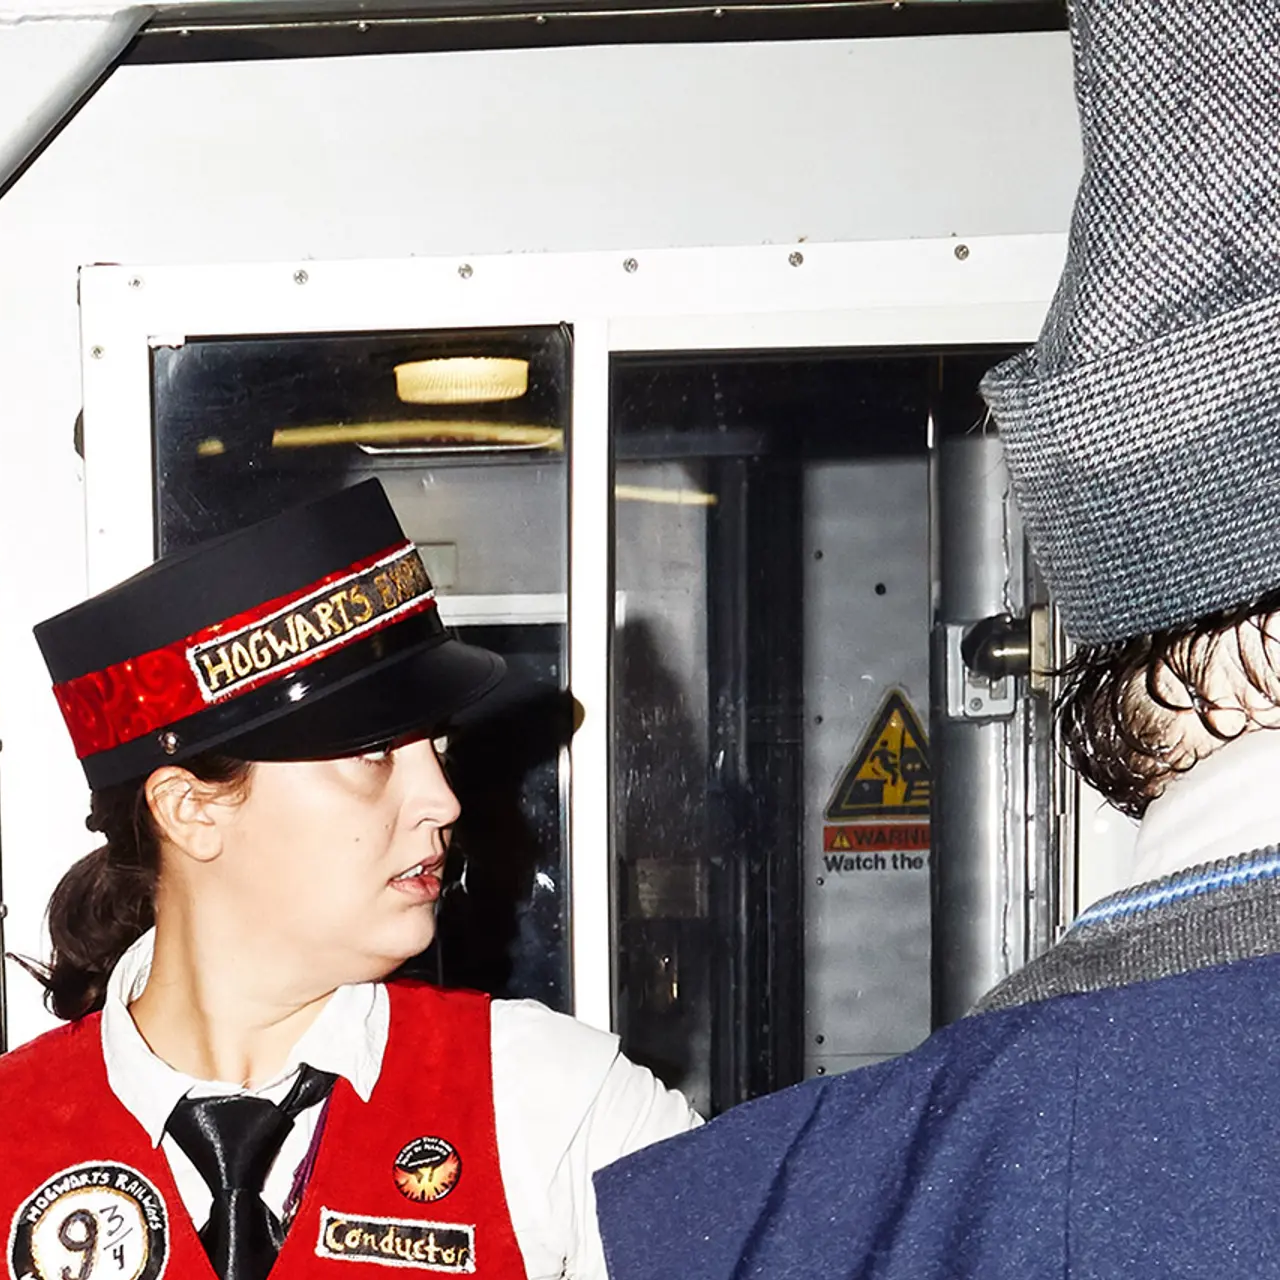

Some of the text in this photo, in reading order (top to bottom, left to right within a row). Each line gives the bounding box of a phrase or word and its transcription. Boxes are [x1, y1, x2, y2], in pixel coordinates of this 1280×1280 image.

[201, 585, 374, 691] HOGWARTS
[824, 853, 886, 873] Watch
[891, 853, 924, 871] the
[27, 1171, 163, 1231] HOGWARTS RAILWAYS
[325, 1219, 468, 1266] Conductor
